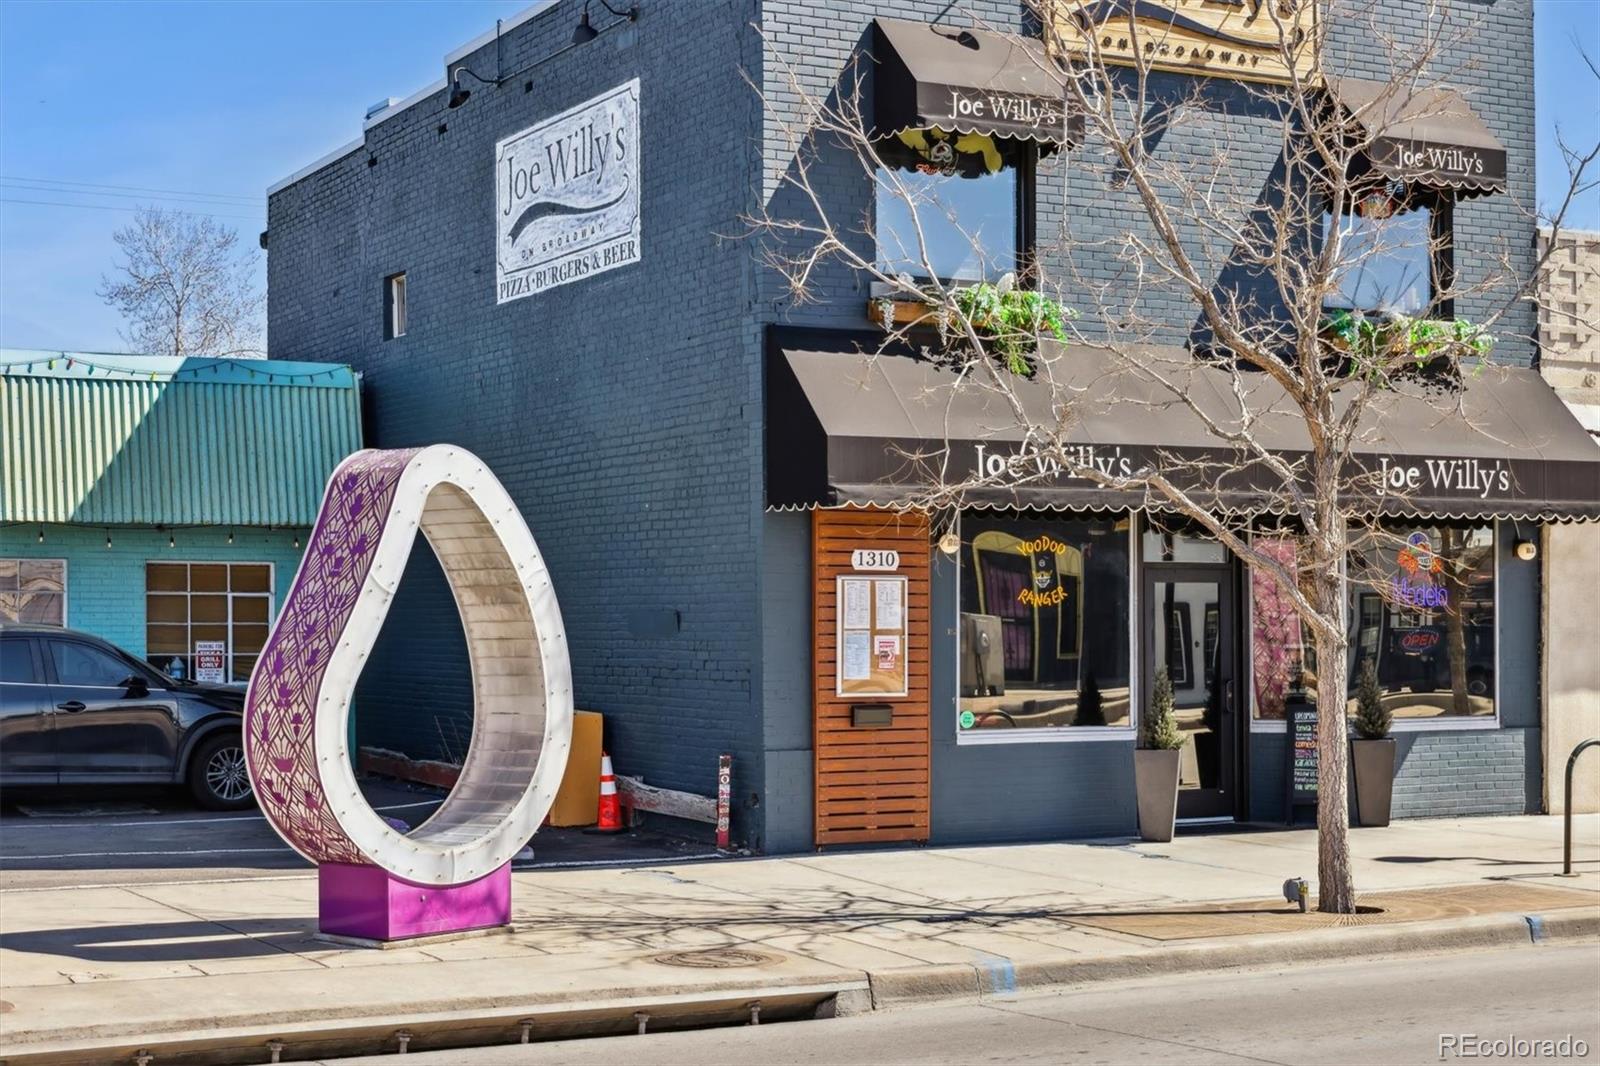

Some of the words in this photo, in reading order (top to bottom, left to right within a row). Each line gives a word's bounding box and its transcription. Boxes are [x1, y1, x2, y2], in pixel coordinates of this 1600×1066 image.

[1101, 36, 1128, 51] ON
[1144, 41, 1260, 68] BROADWAY
[948, 92, 984, 120] Joe
[988, 96, 1056, 128] Willy's
[504, 156, 541, 216] Joe
[545, 112, 626, 185] Willy's
[1395, 144, 1424, 170] Joe
[1427, 148, 1483, 177] Willy's
[521, 247, 534, 261] ON
[542, 222, 604, 253] BROADWAY
[592, 250, 601, 270] &
[603, 239, 636, 267] BEER
[975, 444, 1024, 484] Joe
[1030, 444, 1133, 488] Willy's
[1376, 457, 1420, 496] Joe
[1425, 459, 1509, 499] Willy's
[857, 551, 896, 567] 1310
[1016, 535, 1066, 556] VOODOO
[1018, 586, 1068, 607] RANGER
[1392, 576, 1448, 608] Modelo
[1402, 634, 1440, 646] OPEN
[1294, 711, 1318, 720] UPCOMIN
